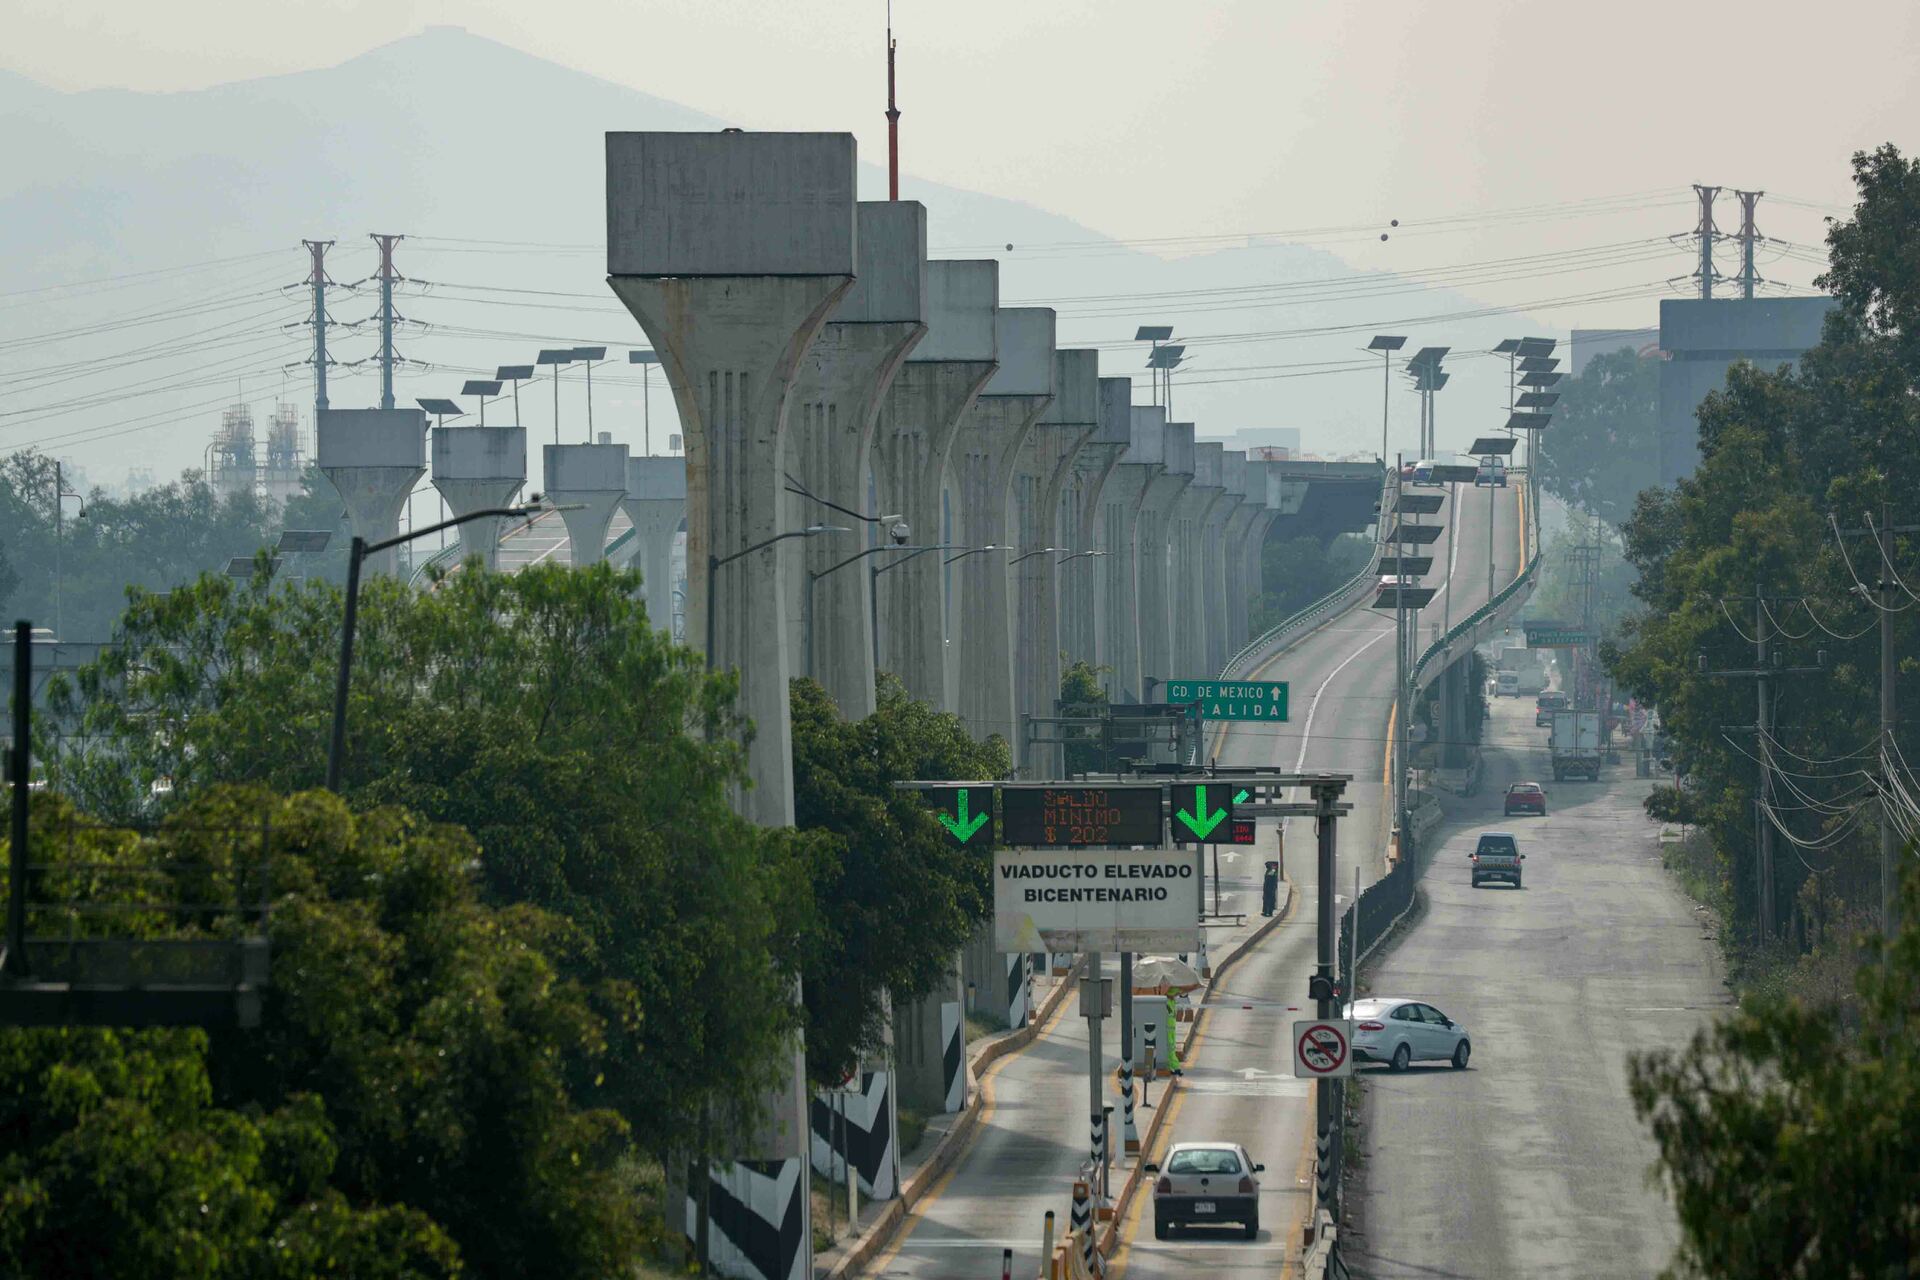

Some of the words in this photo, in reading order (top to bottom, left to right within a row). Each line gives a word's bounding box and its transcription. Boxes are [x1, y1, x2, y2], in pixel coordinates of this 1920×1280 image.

[1172, 685, 1190, 697] CD.
[1198, 686, 1212, 698] DE
[1219, 686, 1264, 699] MEXICO
[1043, 808, 1121, 825] MINIMO
[1070, 826, 1108, 843] 202
[1000, 864, 1098, 879] VIADUCTO
[1104, 864, 1193, 879] ELEVADO
[1024, 887, 1168, 902] BICENTENARIO
